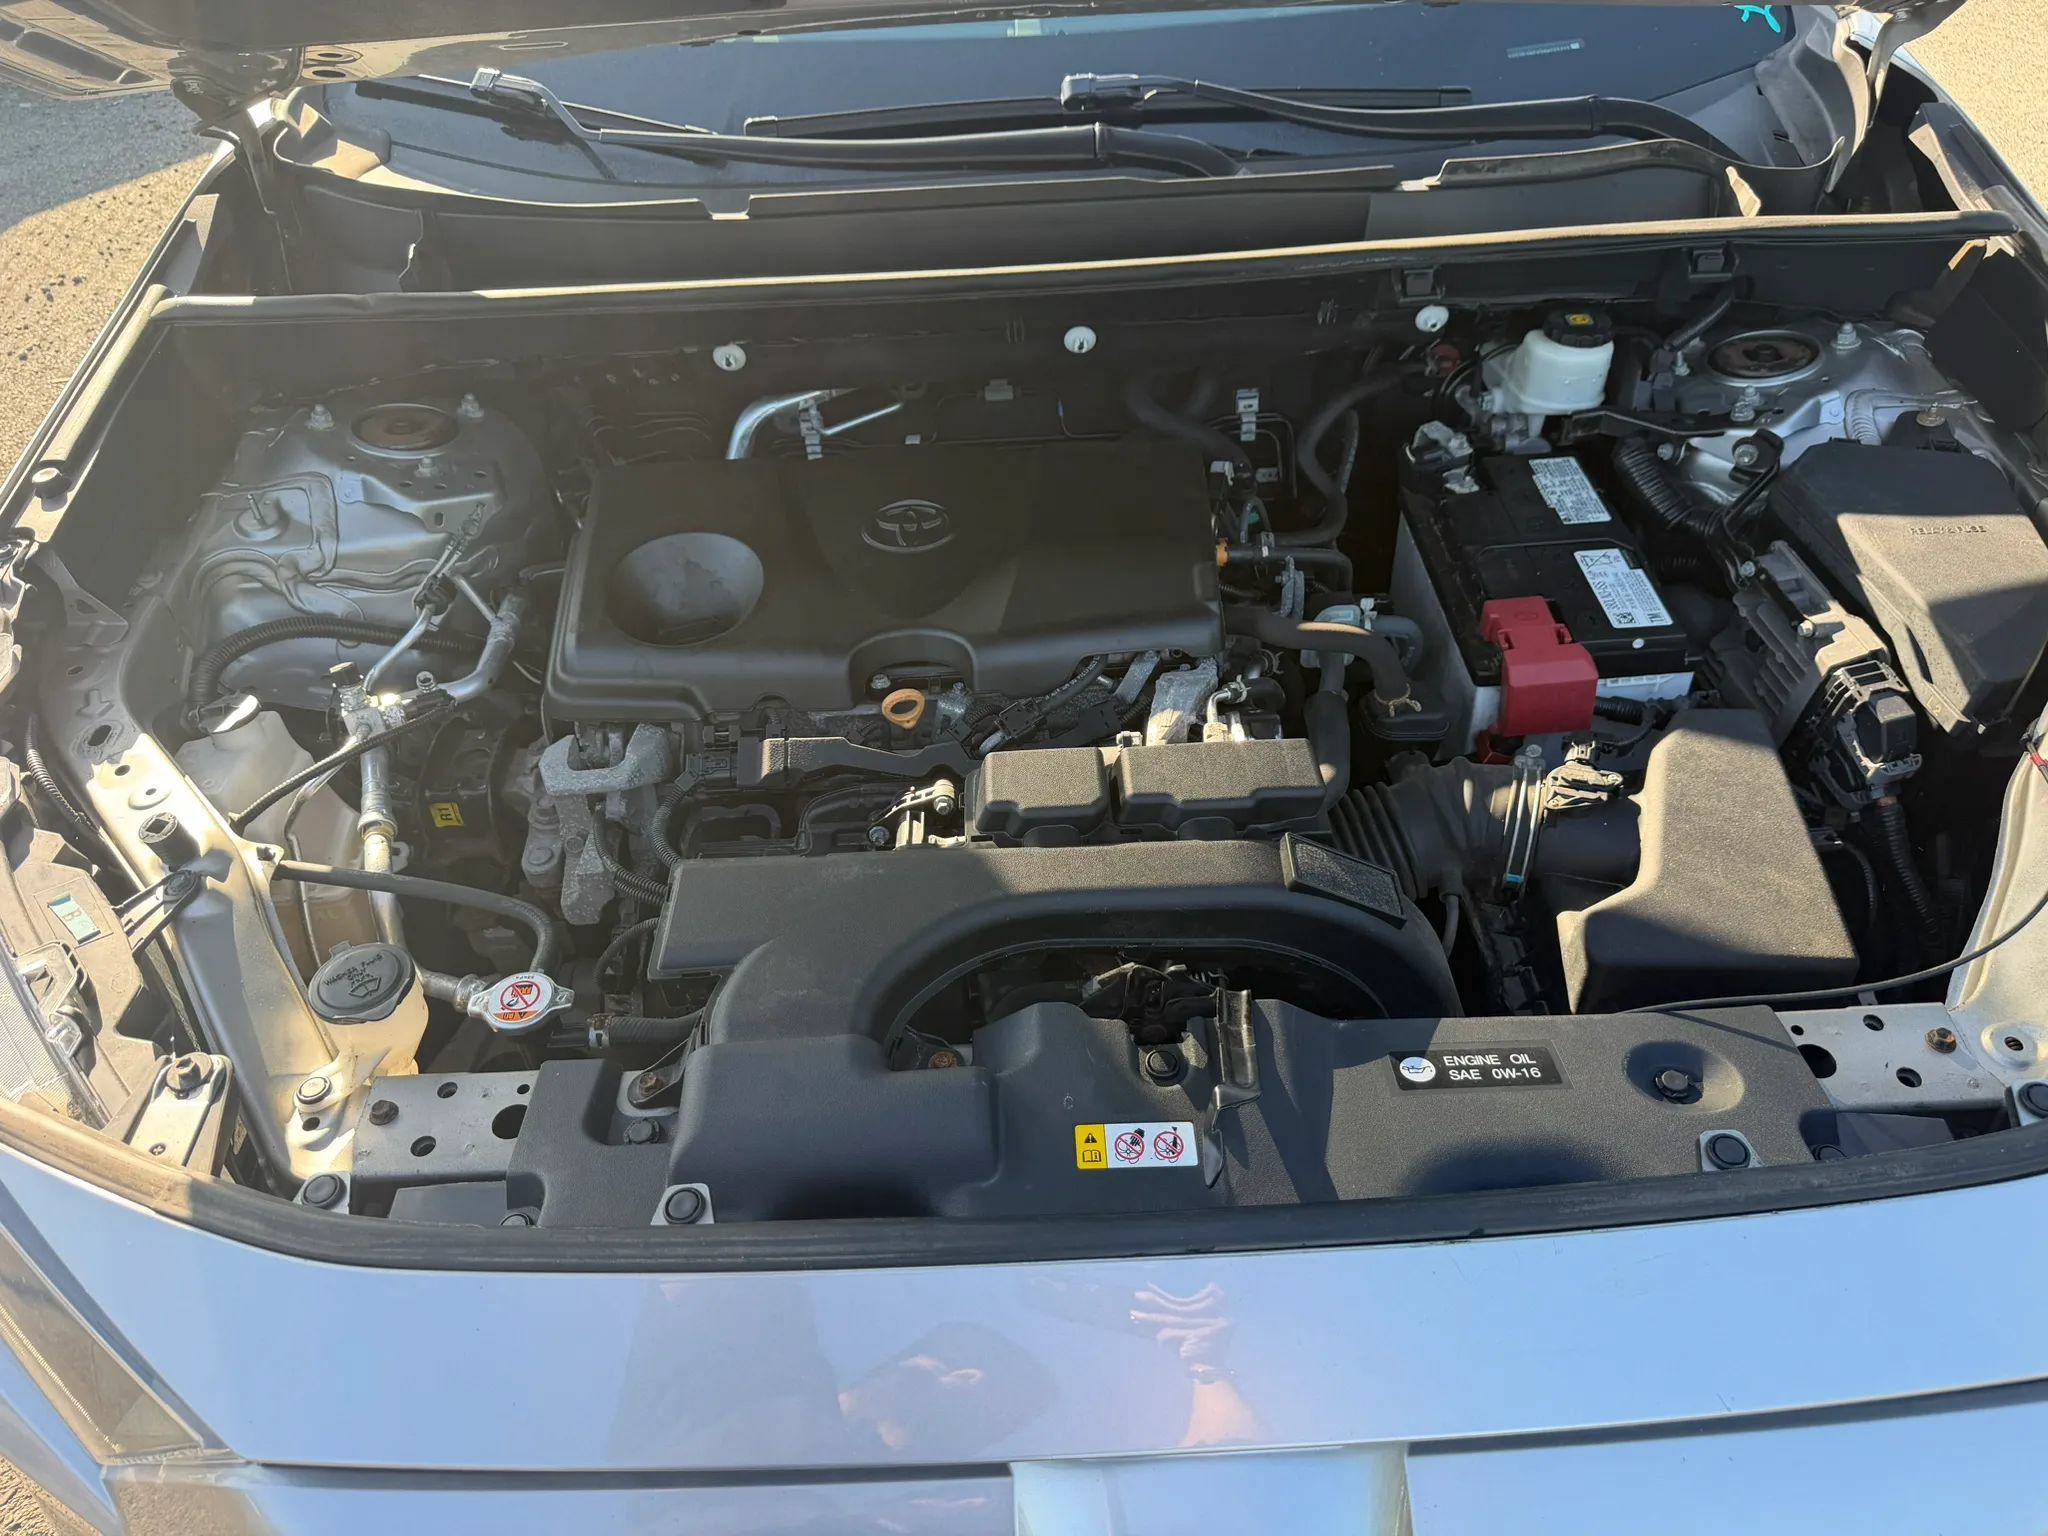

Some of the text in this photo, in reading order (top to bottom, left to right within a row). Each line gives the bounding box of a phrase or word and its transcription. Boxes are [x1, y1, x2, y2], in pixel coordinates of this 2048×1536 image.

[1442, 1053, 1537, 1067] ENGINE OIL
[1448, 1067, 1542, 1081] SAE 0W-16
